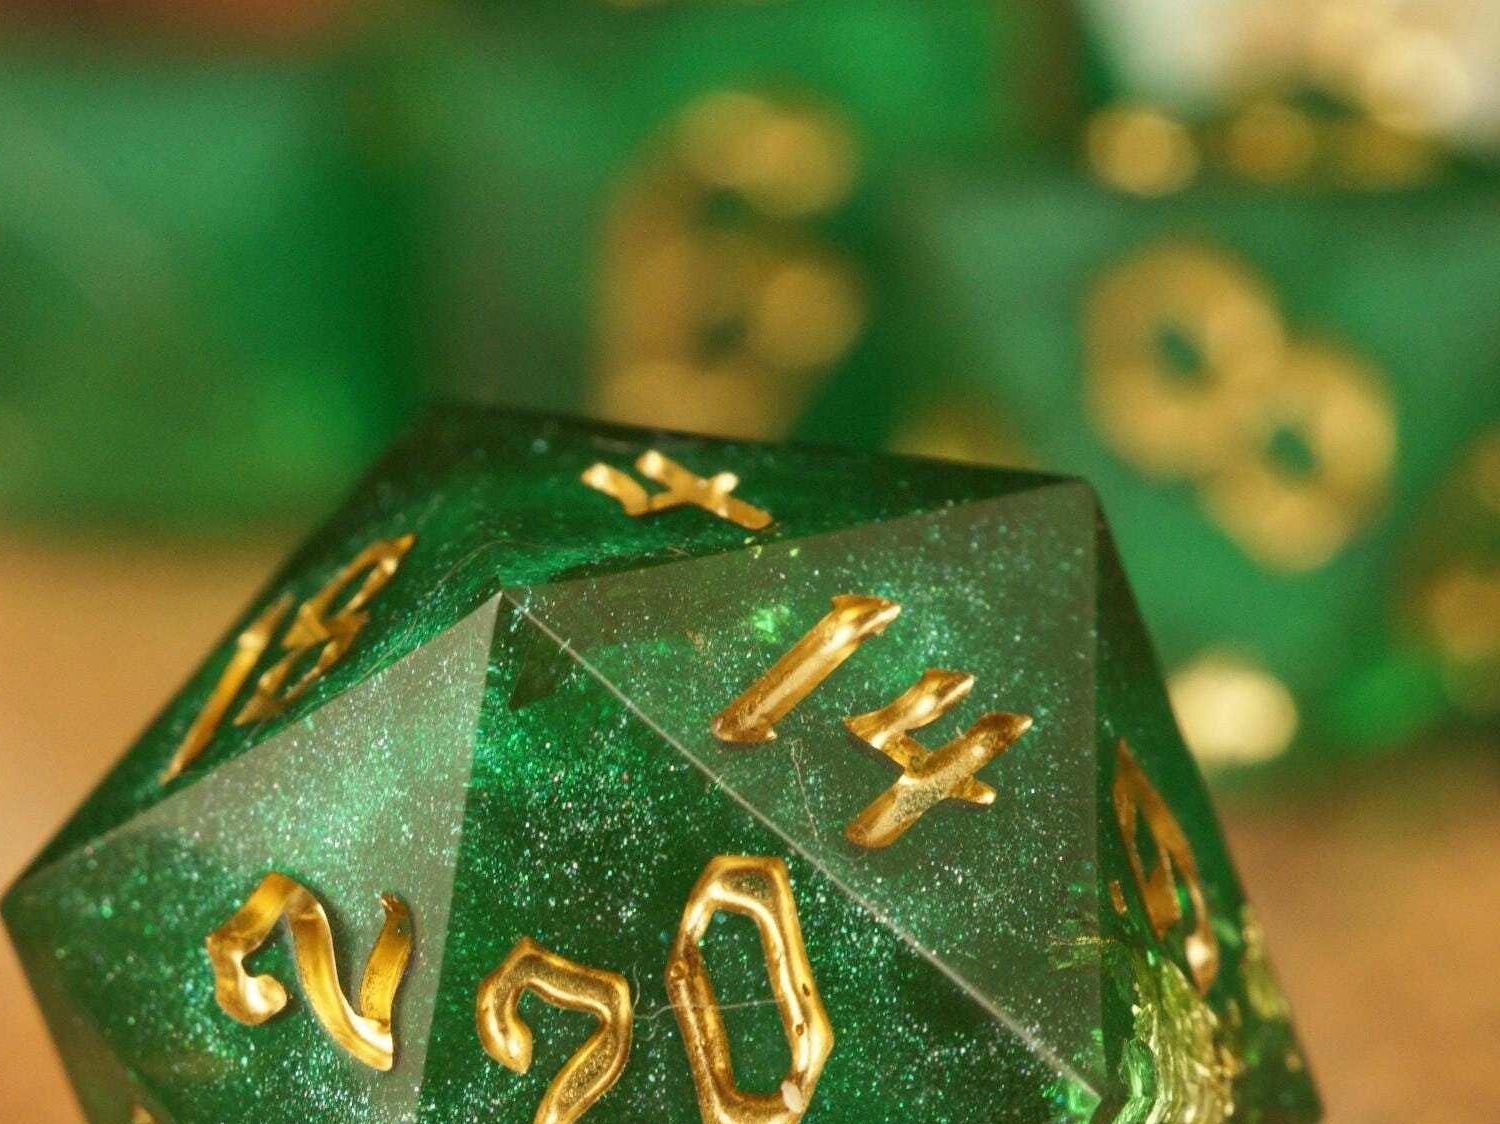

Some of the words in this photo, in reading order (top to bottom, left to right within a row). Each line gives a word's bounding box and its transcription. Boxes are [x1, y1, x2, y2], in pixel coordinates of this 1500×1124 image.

[582, 449, 773, 530] 4
[160, 532, 419, 786] 18
[710, 593, 1034, 849] 14
[205, 871, 416, 1072] 2
